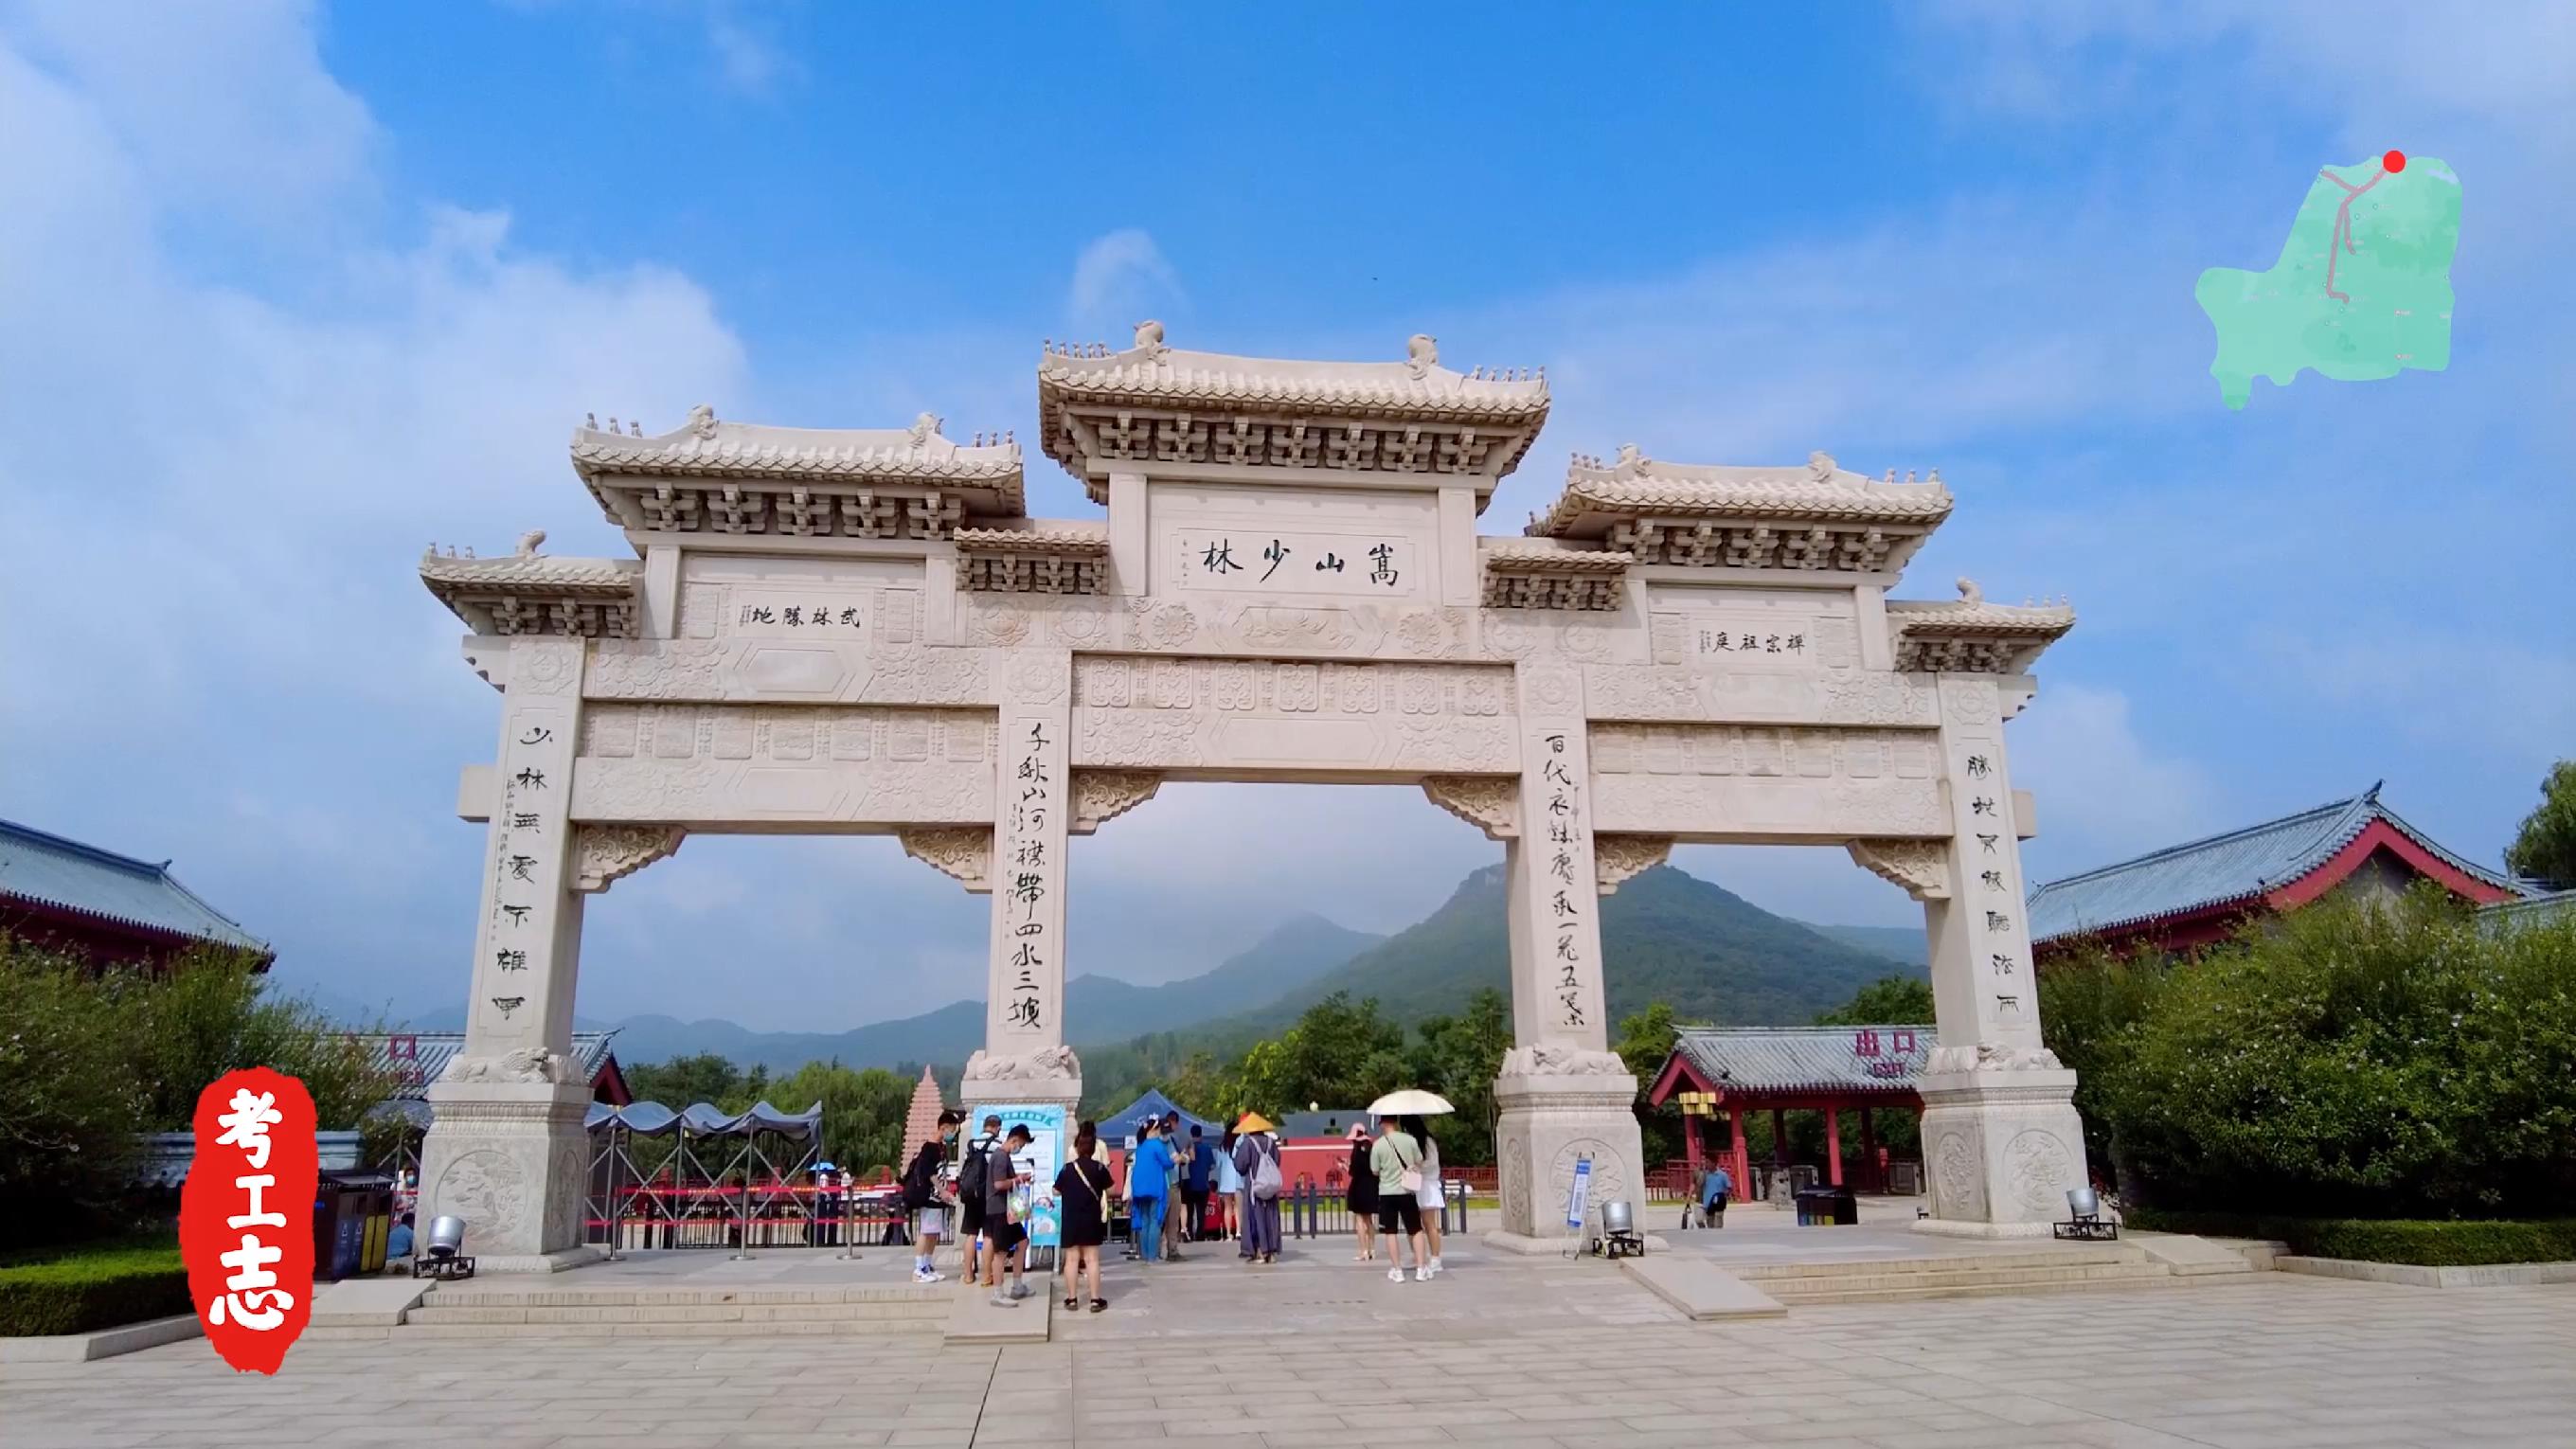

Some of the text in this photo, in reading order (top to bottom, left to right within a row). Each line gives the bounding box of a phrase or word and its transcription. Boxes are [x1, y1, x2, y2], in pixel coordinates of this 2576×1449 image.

[1199, 538, 1399, 586] 嵩山少林
[1855, 1029, 1916, 1057] 出口
